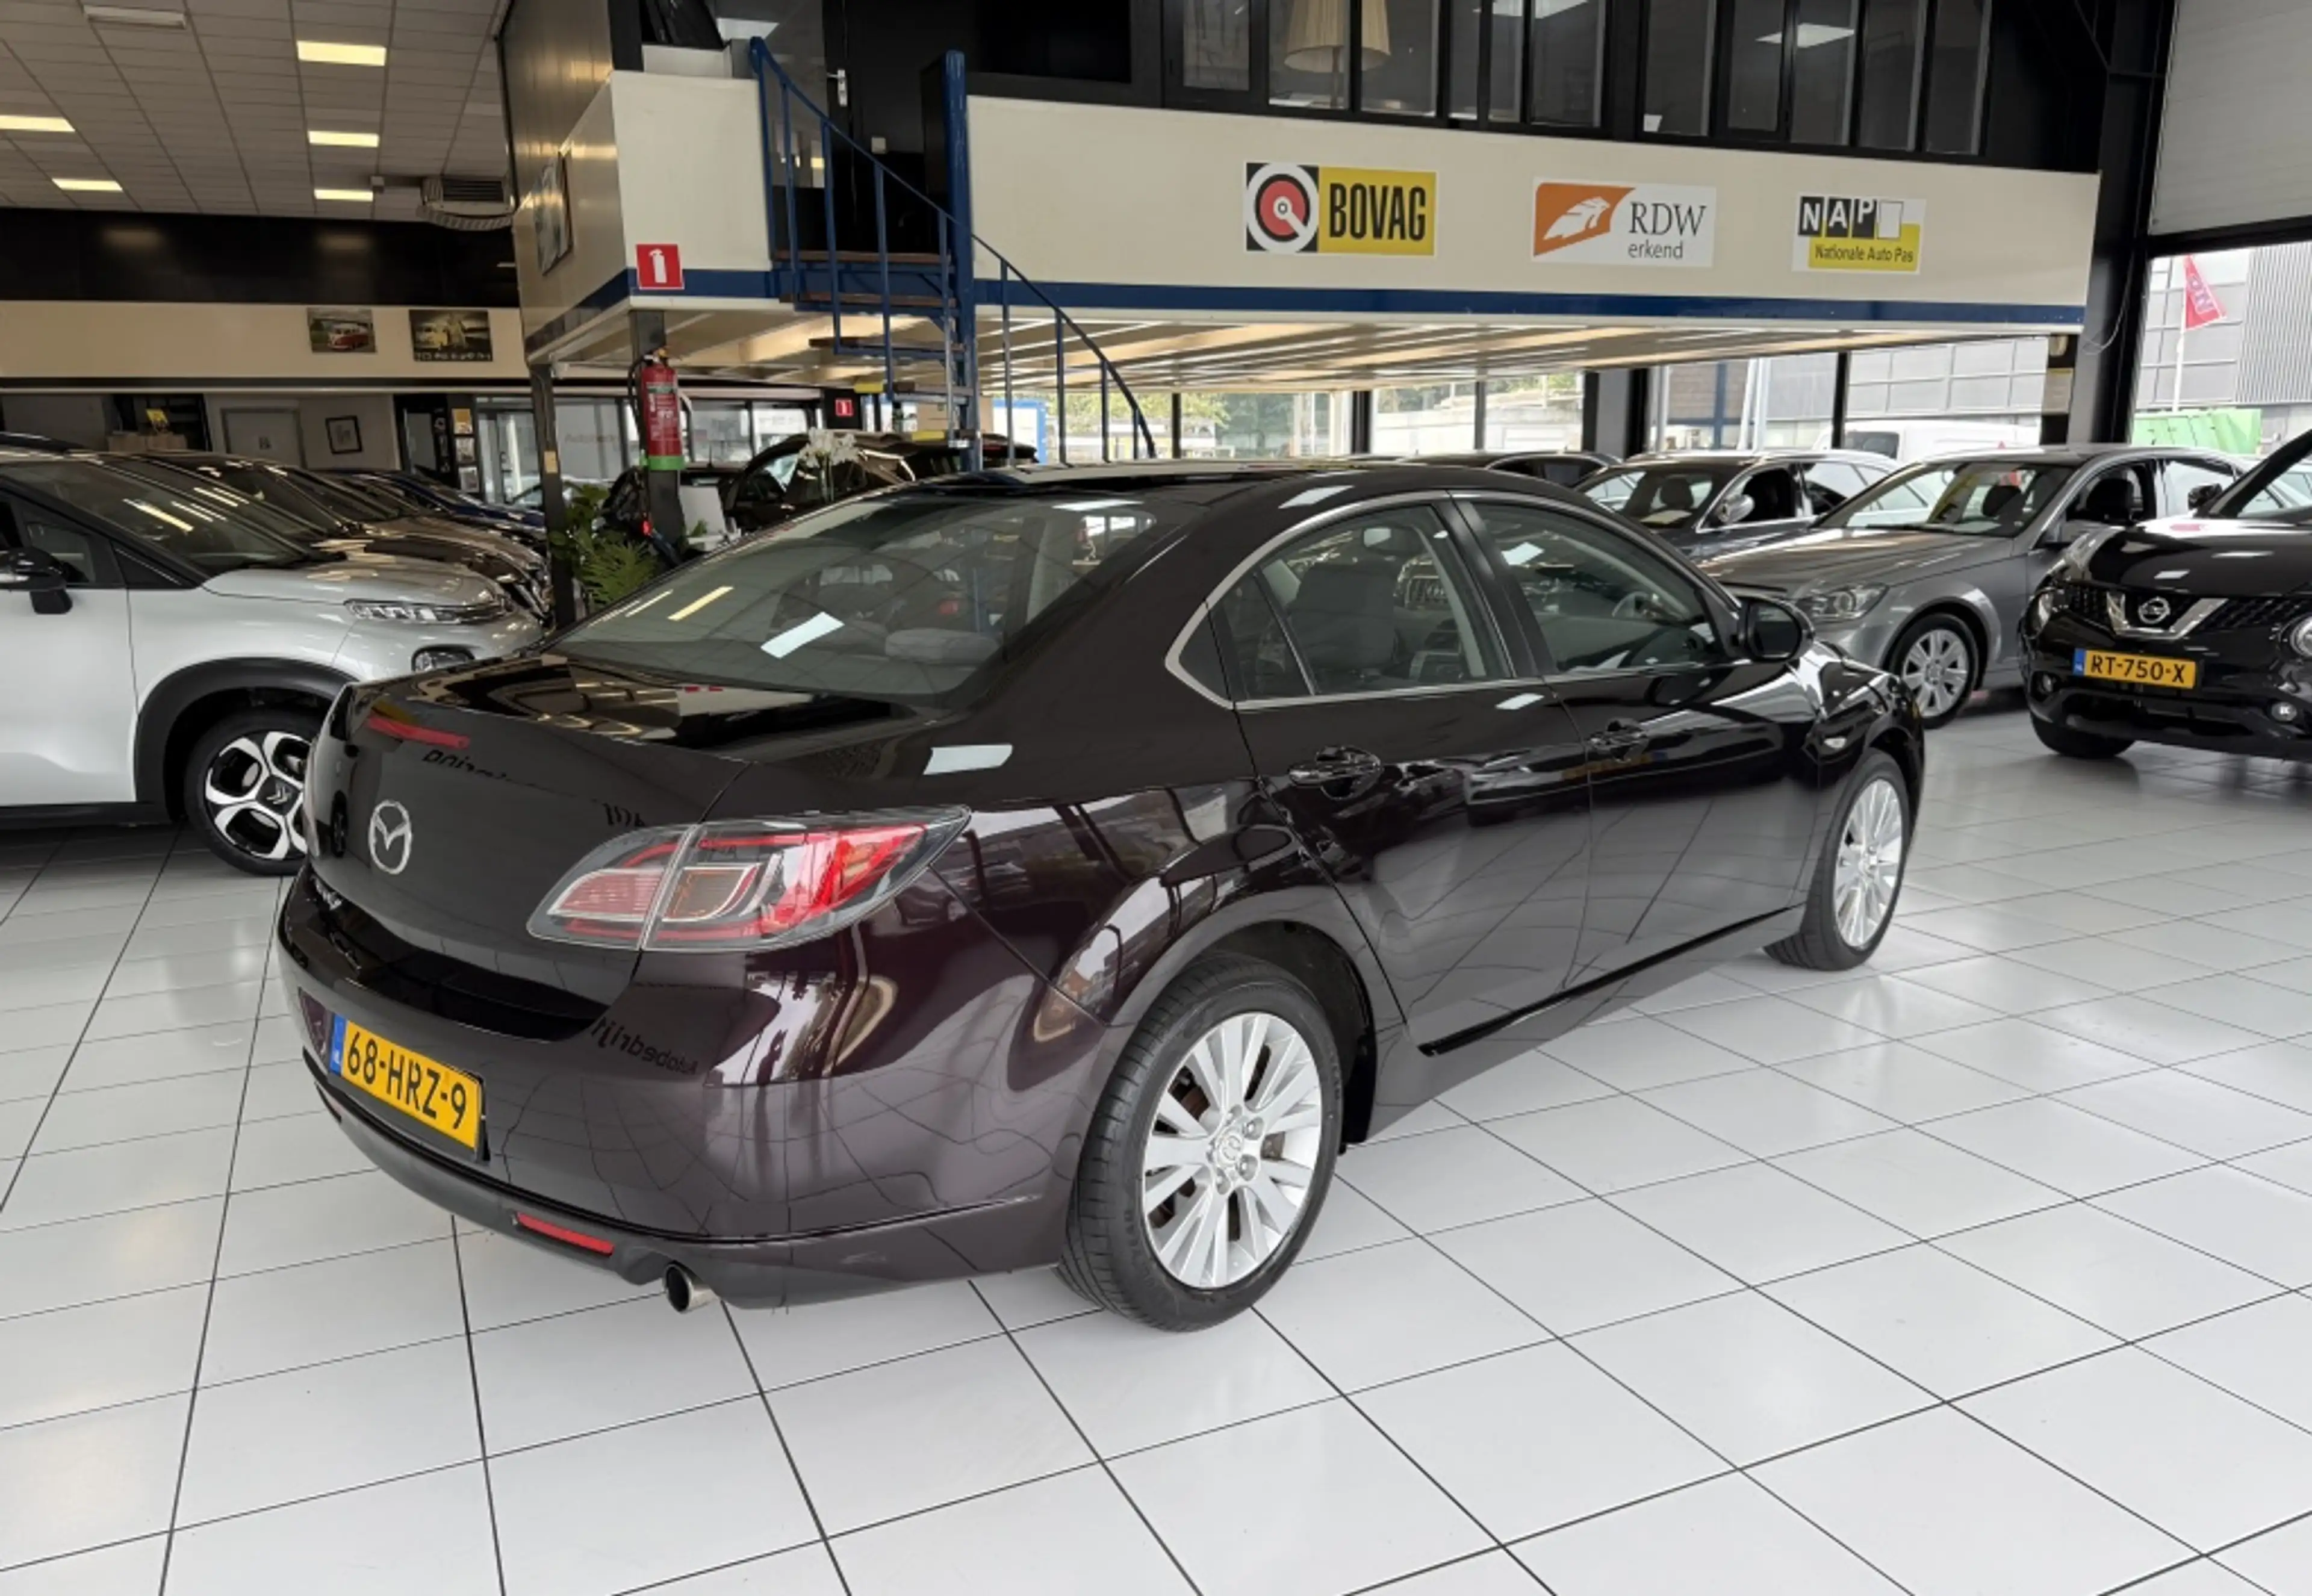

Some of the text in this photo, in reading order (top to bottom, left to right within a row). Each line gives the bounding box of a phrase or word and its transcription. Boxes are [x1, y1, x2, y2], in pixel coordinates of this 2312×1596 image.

[1329, 182, 1426, 242] BOVAG
[1629, 202, 1708, 236] RDW
[1801, 198, 1874, 232] NAP
[1627, 240, 1684, 260] erkend
[1815, 243, 1914, 262] Nationale Auto Pas
[2090, 654, 2186, 683] RT-750-X
[347, 1031, 467, 1130] 68-HRZ-9
